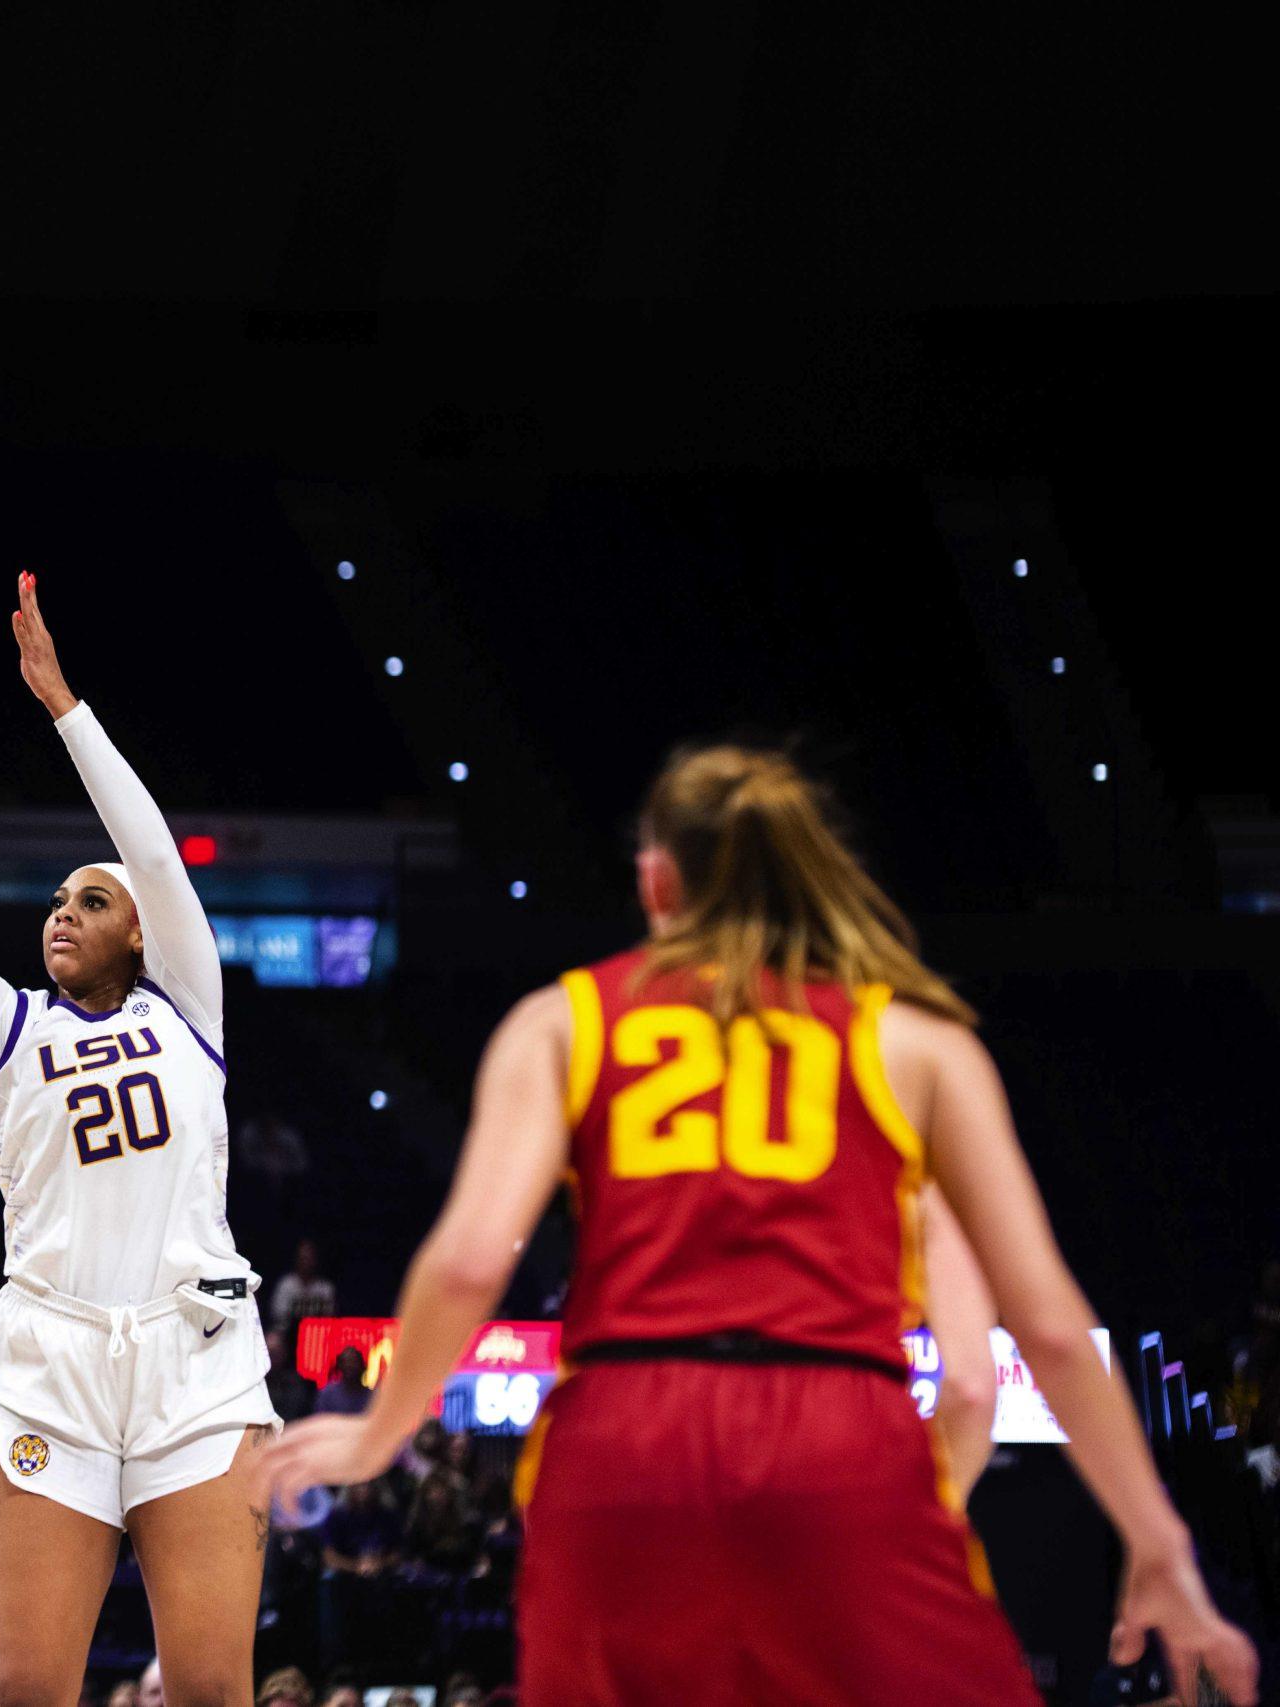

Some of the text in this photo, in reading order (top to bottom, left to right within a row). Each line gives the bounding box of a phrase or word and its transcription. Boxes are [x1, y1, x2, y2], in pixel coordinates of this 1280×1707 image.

[38, 1026, 162, 1084] LSU
[610, 1005, 841, 1184] 20
[66, 1071, 172, 1167] 20
